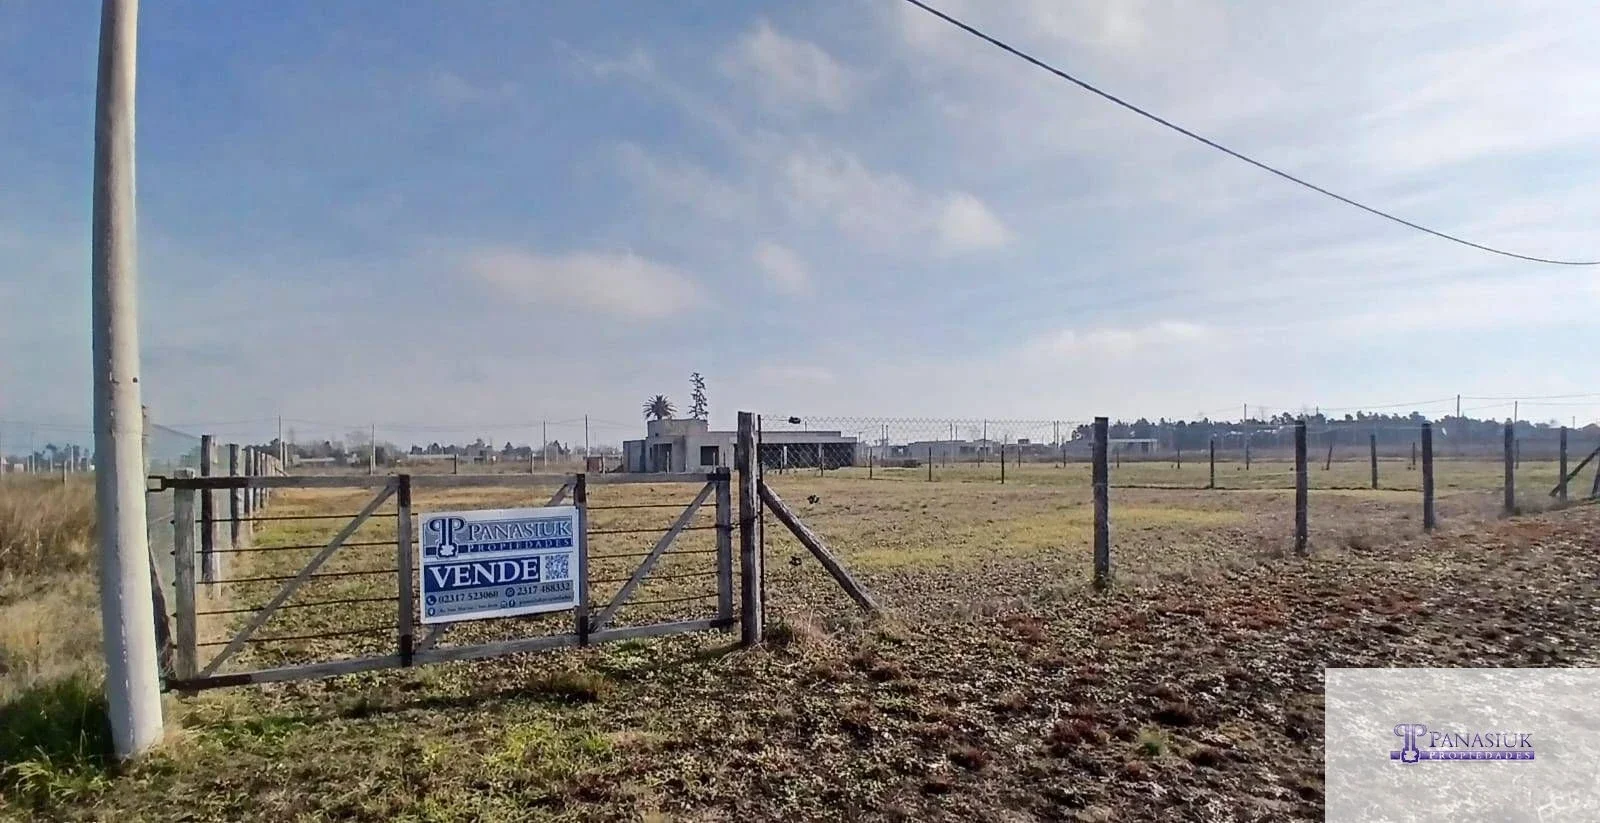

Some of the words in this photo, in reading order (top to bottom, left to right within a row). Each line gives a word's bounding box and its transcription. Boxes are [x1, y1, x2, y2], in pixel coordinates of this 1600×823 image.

[468, 520, 572, 542] PANASIUK
[467, 539, 570, 553] PROPIEDADES
[428, 558, 539, 588] VENDE
[517, 585, 538, 597] 2317
[541, 583, 570, 594] 488332
[438, 593, 465, 604] 02317
